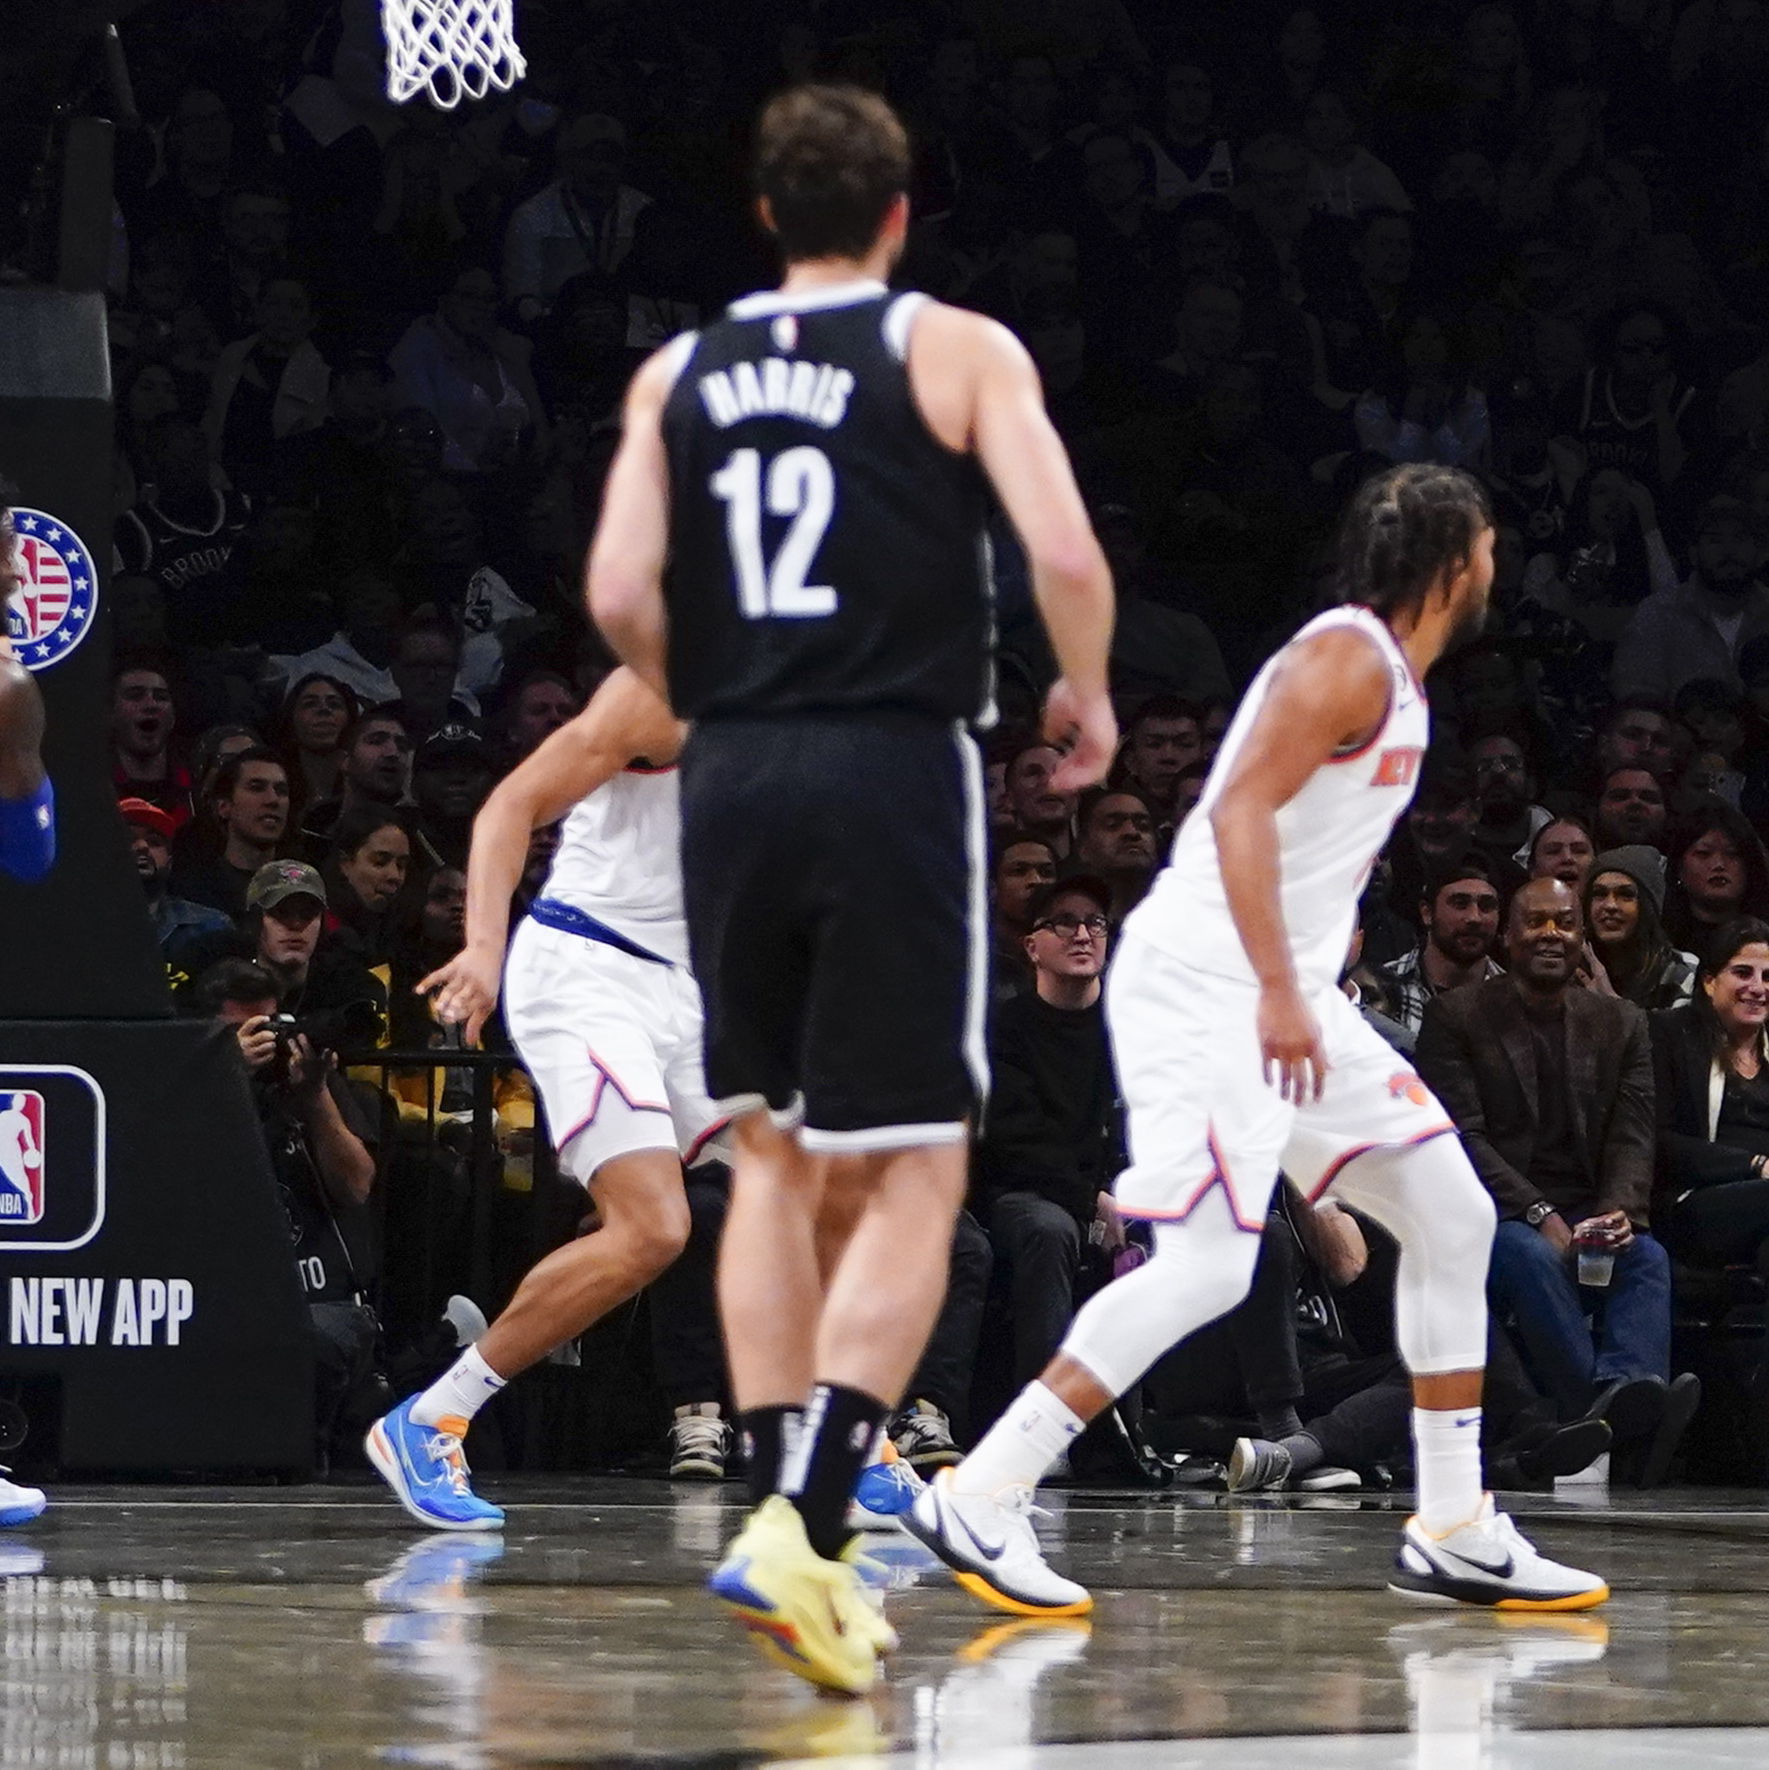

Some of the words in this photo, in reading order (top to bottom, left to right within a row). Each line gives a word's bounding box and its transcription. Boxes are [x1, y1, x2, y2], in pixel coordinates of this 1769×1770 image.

[697, 357, 856, 429] HARRIS
[709, 445, 838, 621] 12
[12, 1278, 104, 1346] NEW
[112, 1278, 193, 1346] APP
